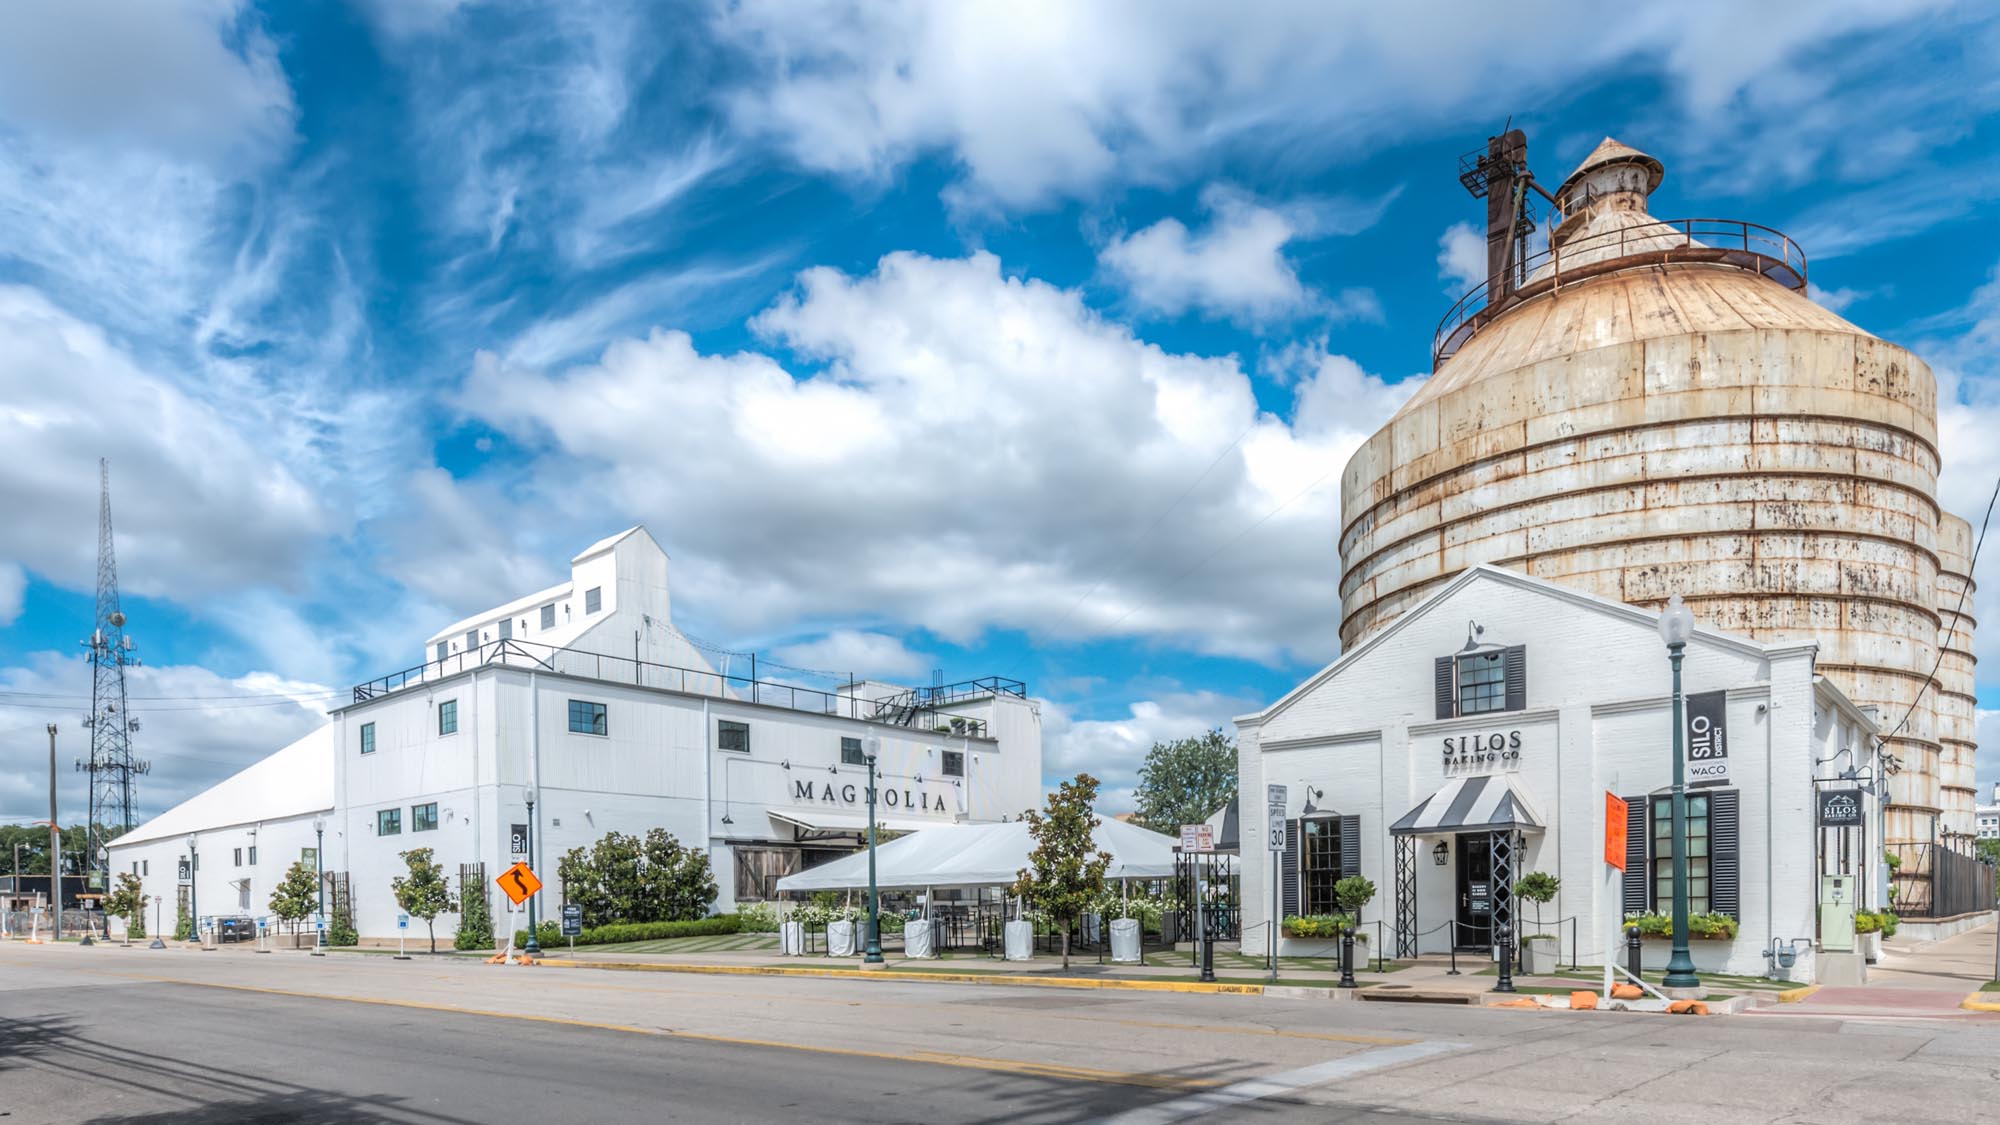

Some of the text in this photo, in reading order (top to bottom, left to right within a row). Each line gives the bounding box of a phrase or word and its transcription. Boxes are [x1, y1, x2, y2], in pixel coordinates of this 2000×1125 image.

[1443, 730, 1521, 755] SILOS
[1691, 715, 1711, 758] SILO
[1714, 727, 1723, 757] DISTRICT
[1444, 752, 1495, 766] BAKING
[1691, 765, 1726, 776] WACO
[795, 780, 946, 811] MAGNOLIA
[1270, 807, 1285, 817] SPEED
[1824, 806, 1857, 815] SILOS
[512, 833, 521, 853] SILO
[1271, 829, 1284, 846] 30
